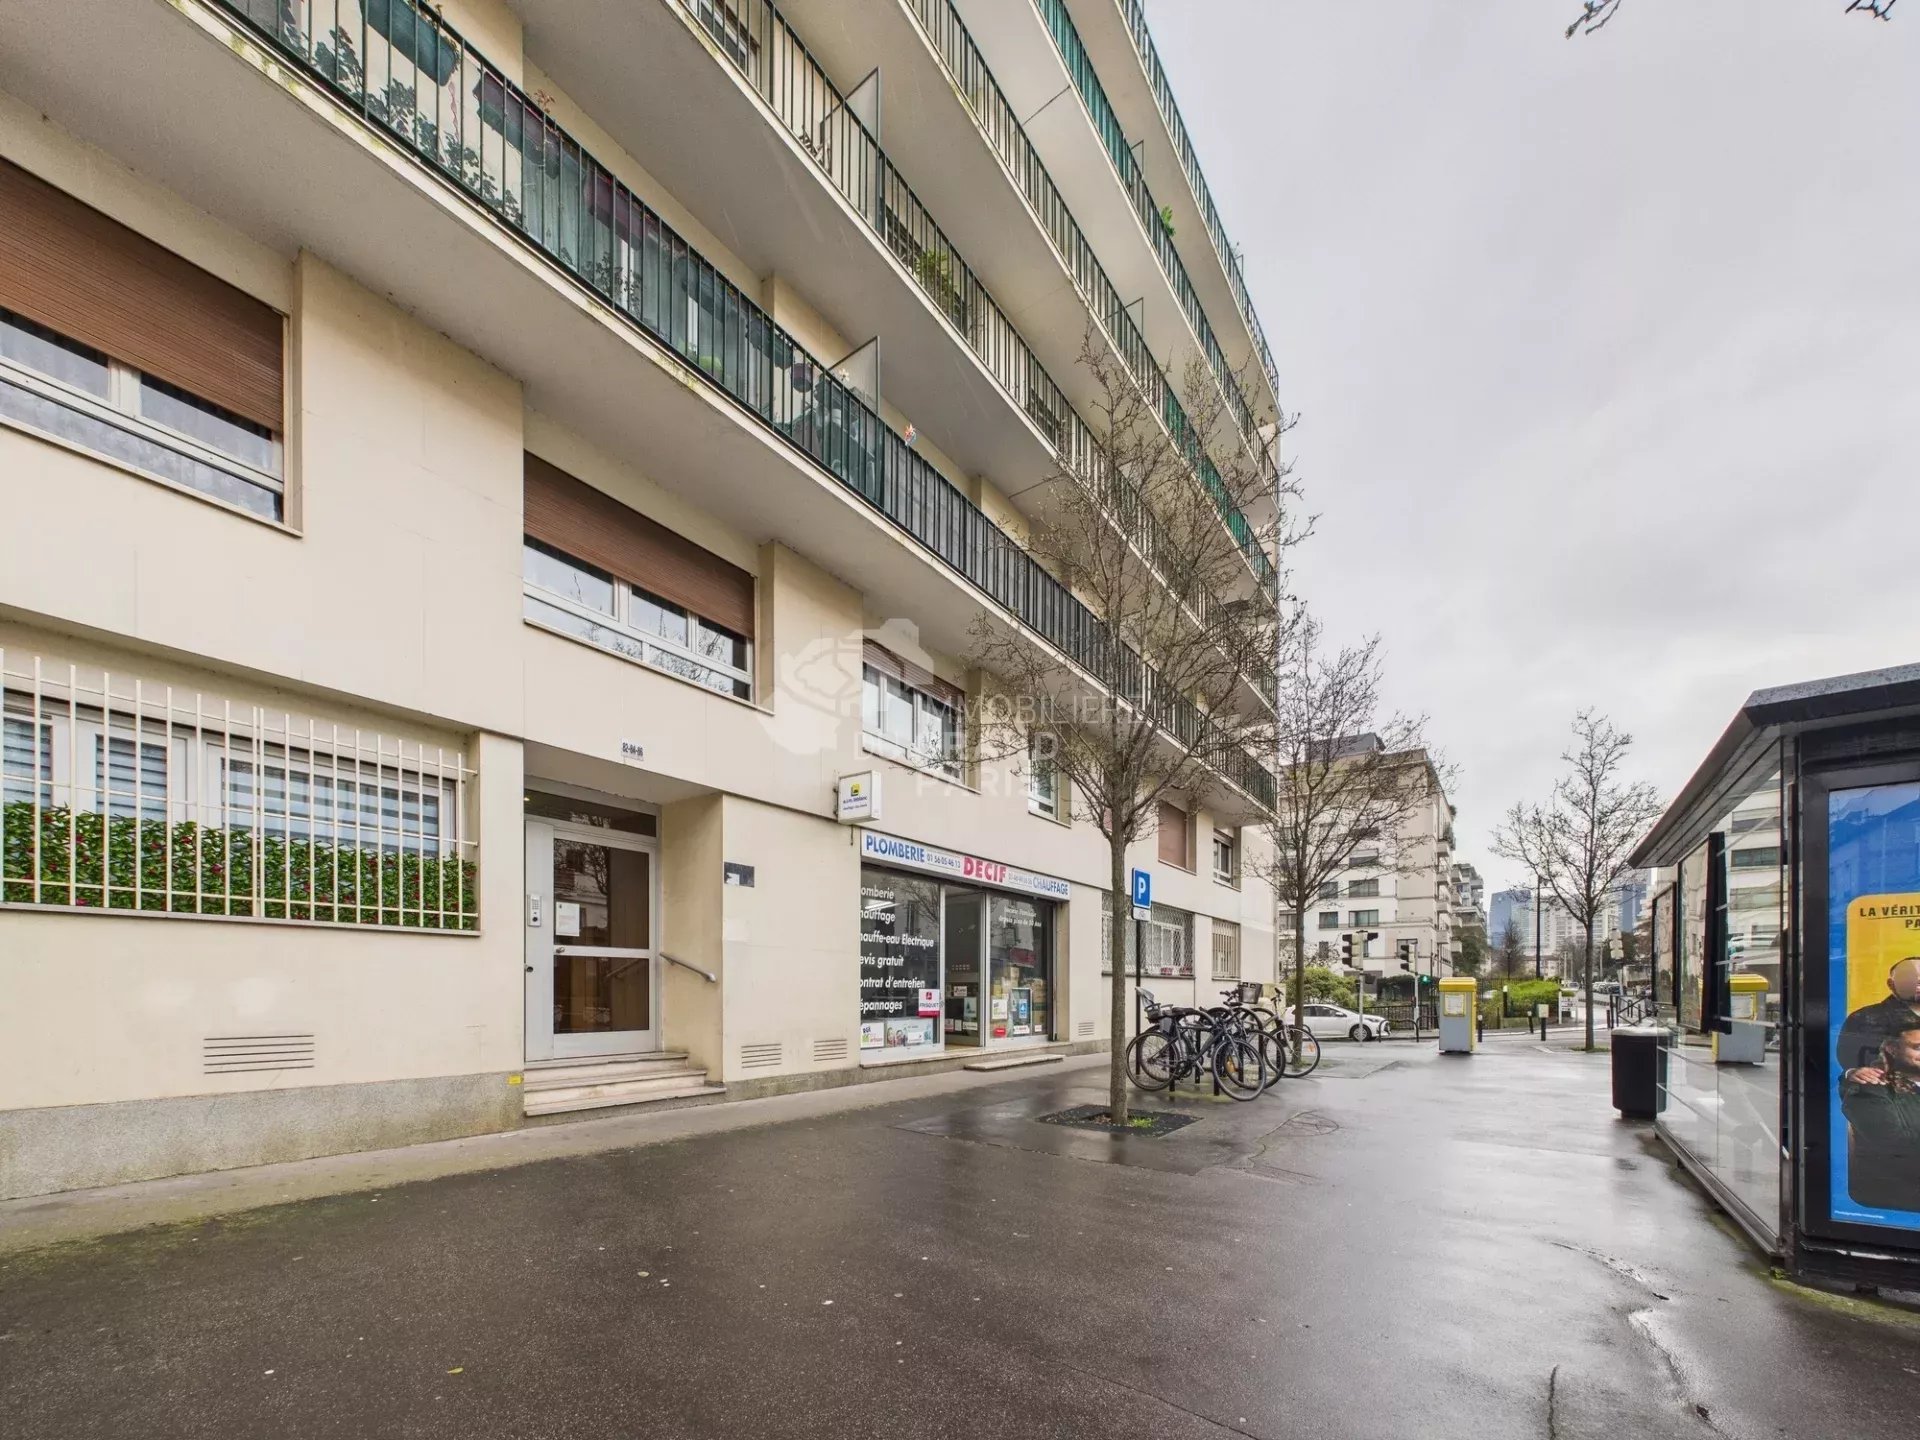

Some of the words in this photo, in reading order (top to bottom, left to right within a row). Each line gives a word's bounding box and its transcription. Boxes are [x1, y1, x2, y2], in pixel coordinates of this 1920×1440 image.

[866, 835, 925, 862] PLOMBERIE
[927, 853, 933, 862] 01
[963, 856, 1007, 883] DECIF
[1032, 876, 1069, 895] CHAUFFAGE
[1138, 877, 1146, 900] P
[1860, 907, 1876, 917] LA
[901, 933, 934, 950] Electrique
[877, 954, 904, 969] gratuit
[885, 975, 926, 989] d'entretien
